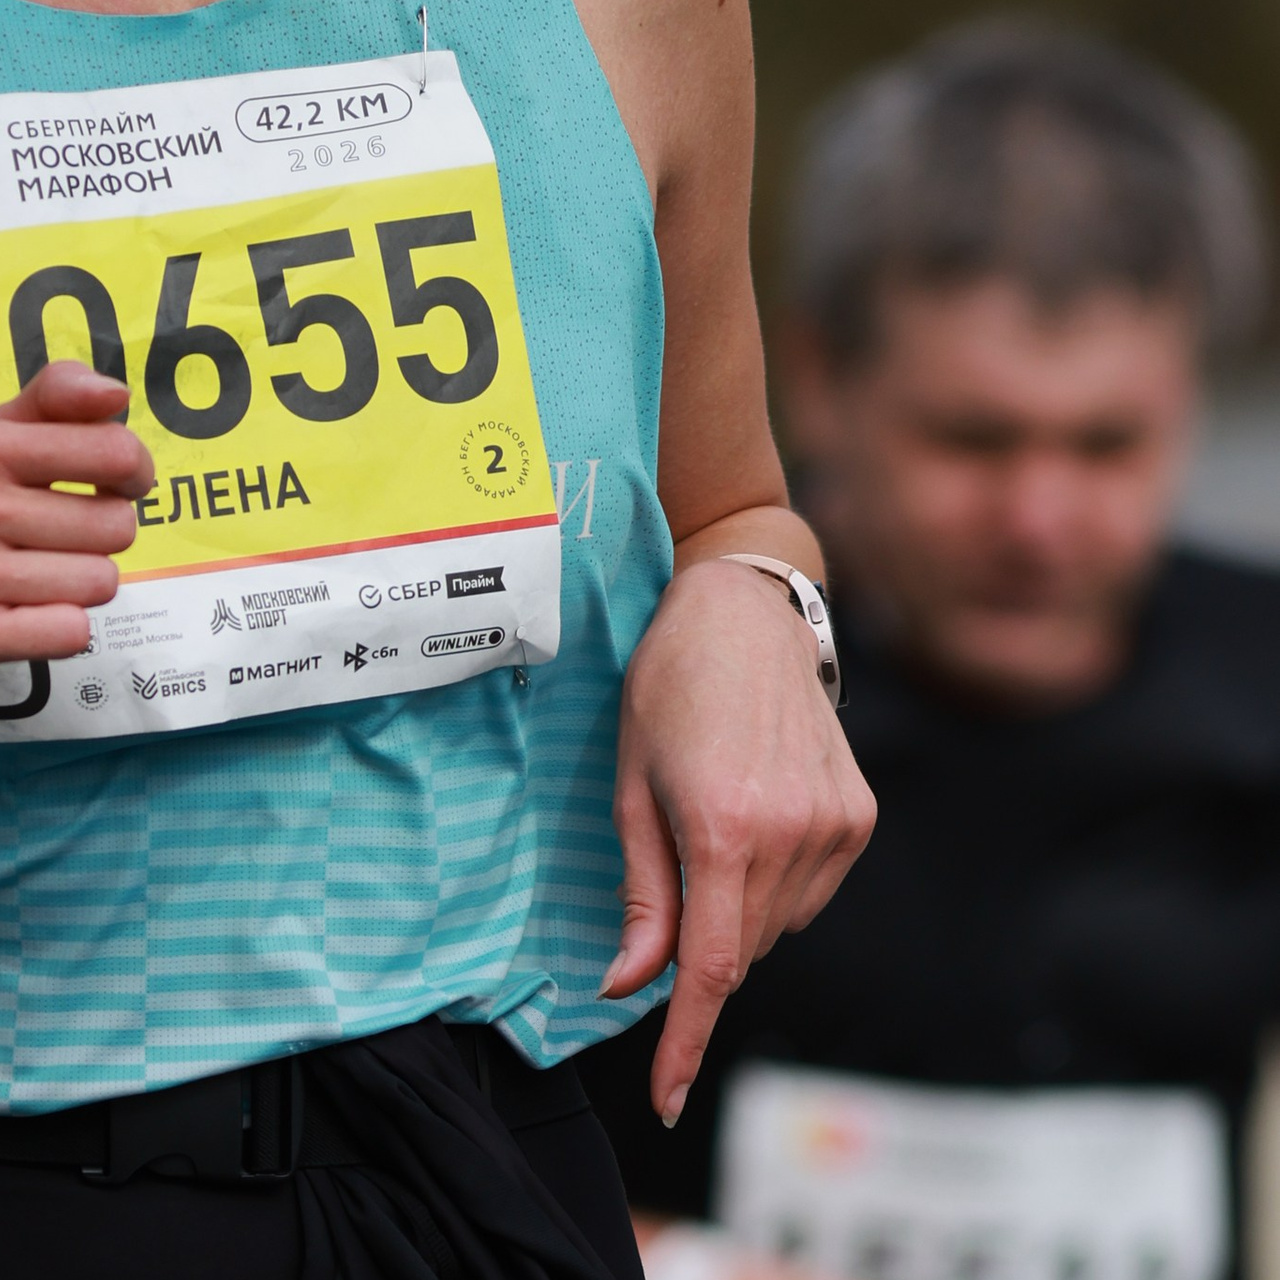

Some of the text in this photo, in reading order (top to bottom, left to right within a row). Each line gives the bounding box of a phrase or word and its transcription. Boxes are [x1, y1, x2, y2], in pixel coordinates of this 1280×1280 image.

[7, 111, 157, 140] СБЕРПРАЙМ
[256, 101, 324, 132] 42,2
[11, 126, 223, 171] МОСКОВСКИЙ
[288, 135, 386, 172] 2026
[17, 166, 173, 202] МАРАФОН
[459, 420, 530, 499] БЕГУ МОСКОВСКИЙ МАРАФОН
[483, 445, 507, 475] 2
[241, 580, 330, 612] МОСКОВСКИЙ
[388, 574, 495, 601] СБЕР Прайм
[104, 609, 168, 627] Департамент
[106, 626, 141, 638] спорта
[246, 608, 288, 630] СПОРТ
[108, 632, 183, 650] города Москвы
[371, 646, 399, 660] сбп
[428, 633, 487, 652] WINLINE
[161, 679, 207, 698] BRICS
